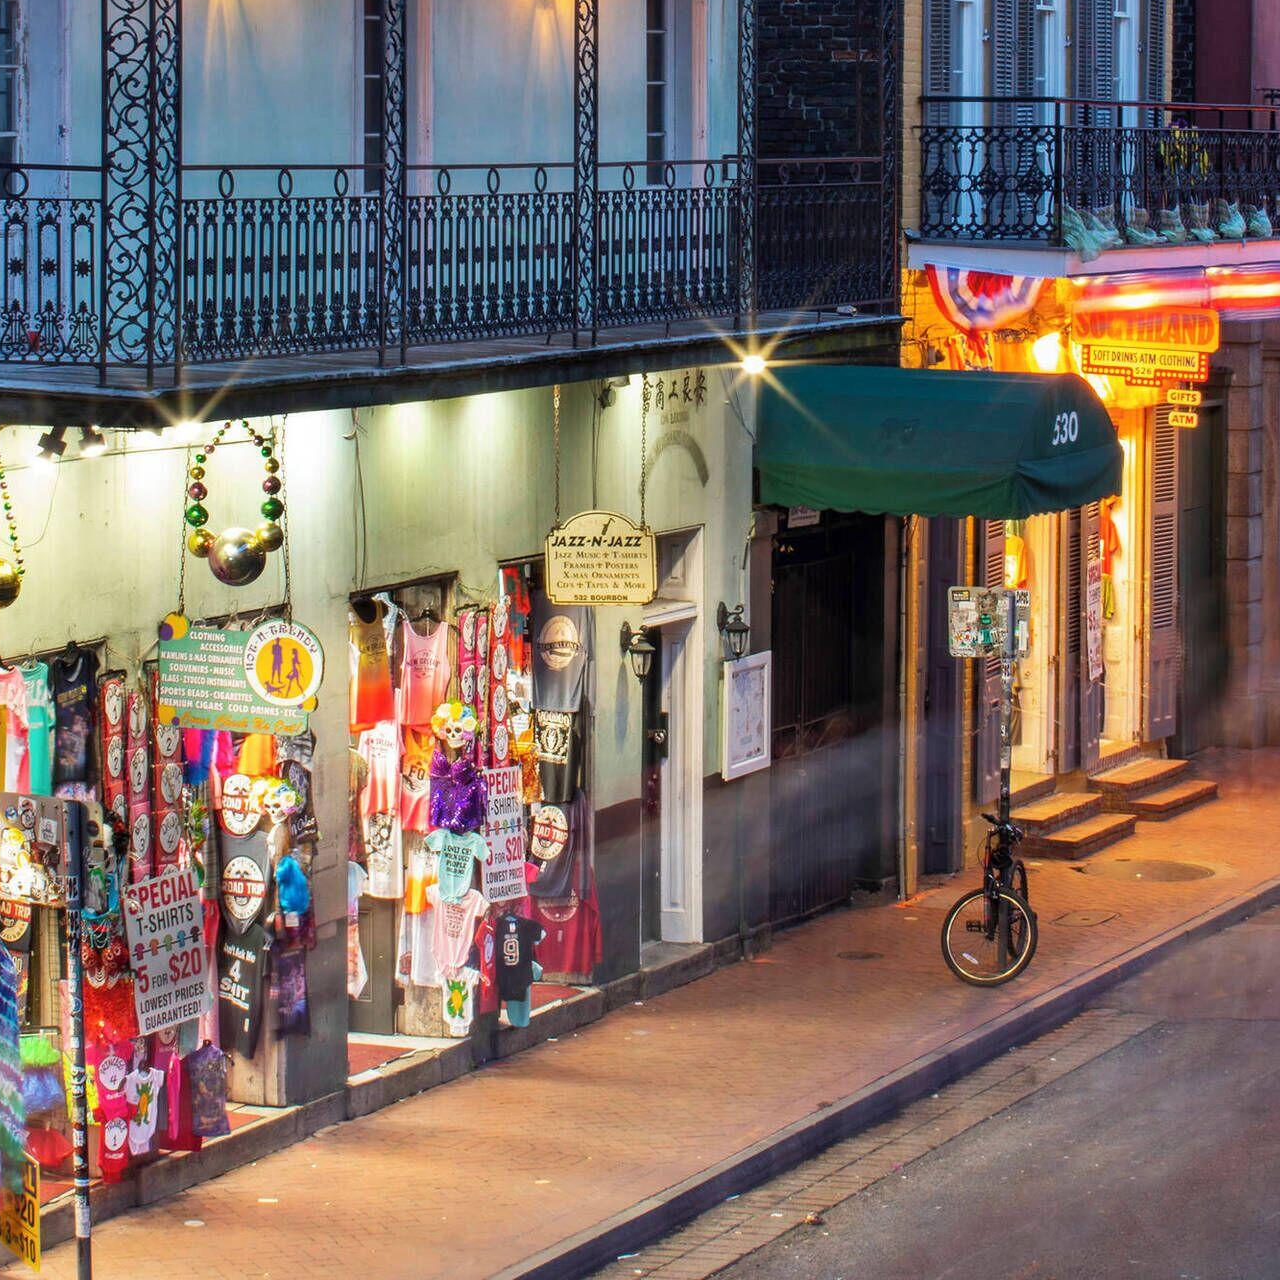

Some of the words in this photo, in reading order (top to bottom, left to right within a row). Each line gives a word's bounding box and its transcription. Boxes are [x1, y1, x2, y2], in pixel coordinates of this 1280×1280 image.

[1093, 349, 1110, 361] SOFT
[1111, 351, 1138, 363] DRINKS
[1139, 353, 1156, 365] ATM
[1159, 354, 1196, 367] CLOTHING
[1170, 392, 1197, 402] GIFTS
[1172, 414, 1194, 424] ATM
[1052, 411, 1078, 446] 530
[552, 536, 642, 547] JAZZ-N-JAZZ
[190, 631, 226, 642] CLOTHING
[200, 643, 243, 654] ACCESSORIES
[169, 663, 208, 673] SOUVENIRS
[213, 666, 235, 676] MUSIC
[162, 674, 179, 683] FLAGS
[160, 686, 185, 696] SPORTS
[213, 690, 253, 702] CIGARETTES
[160, 698, 193, 708] PREMIUM
[195, 700, 224, 711] CIGARS
[228, 703, 249, 713] COLD
[251, 705, 279, 715] DRINKS
[494, 852, 505, 865] FOR
[486, 870, 508, 884] LOWEST
[127, 872, 198, 916] SPECIAL
[246, 882, 265, 895] TRIP
[136, 903, 194, 937] T-SHIRTS
[503, 938, 520, 966] 9
[137, 965, 149, 993] 5
[152, 972, 169, 989] FOR
[169, 947, 202, 986] $20
[228, 959, 241, 982] 4
[140, 993, 173, 1014] LOWEST
[175, 981, 205, 1001] PRICES
[145, 1000, 202, 1030] GUARANTEED!
